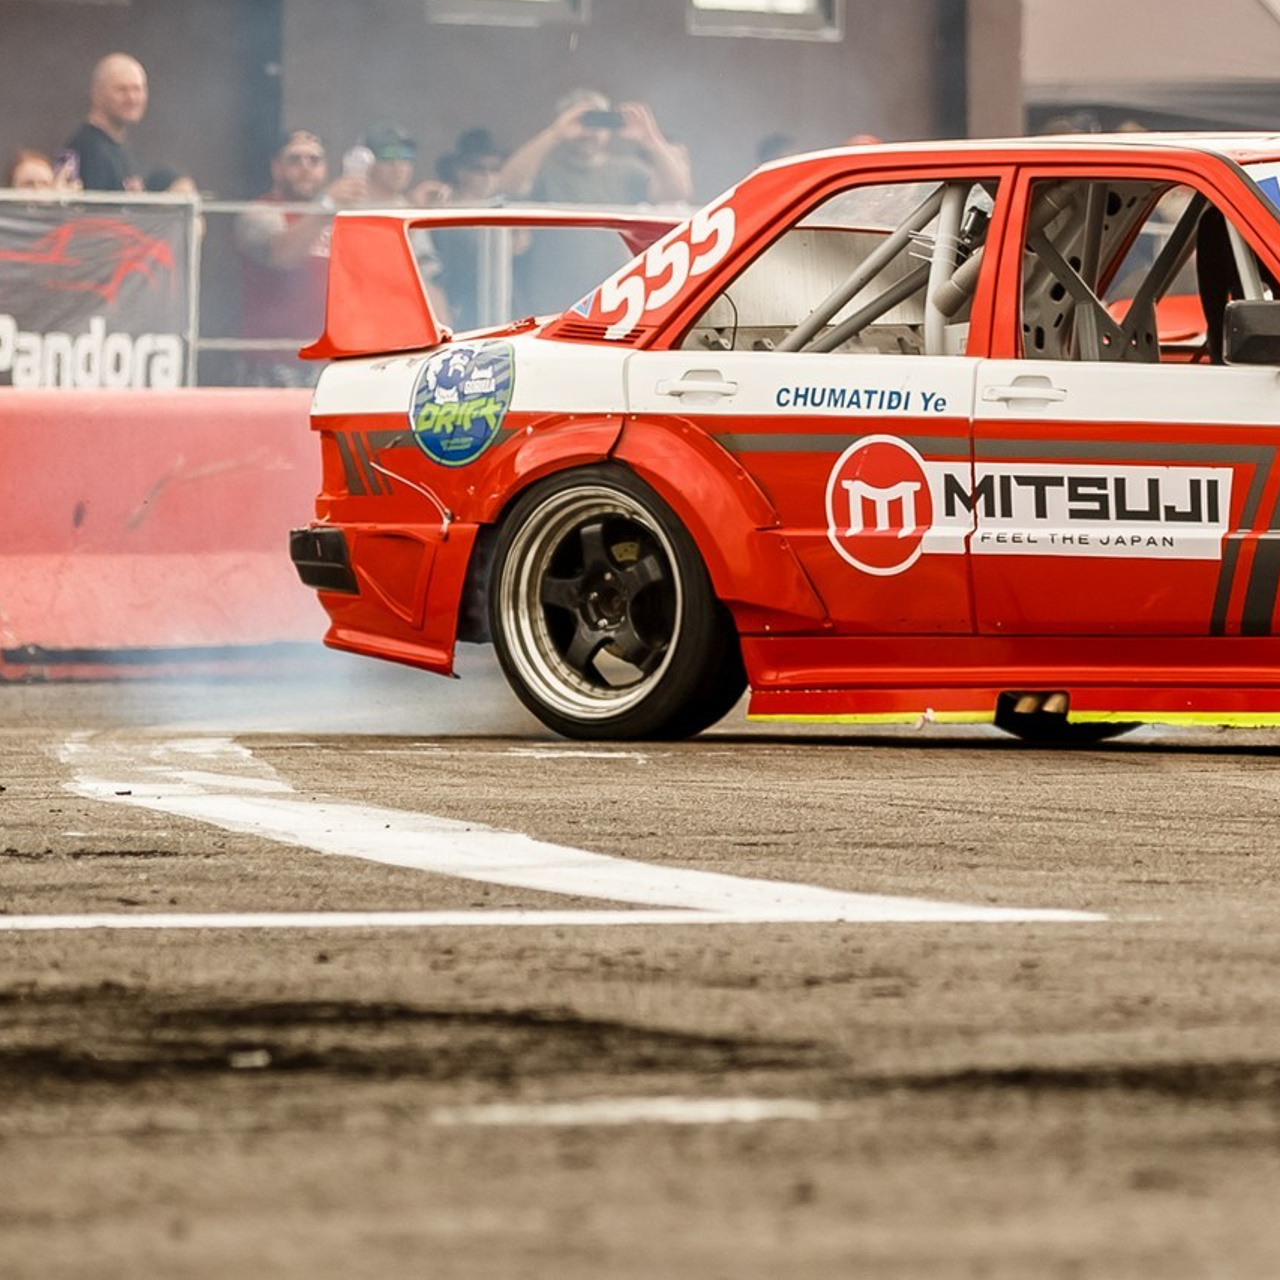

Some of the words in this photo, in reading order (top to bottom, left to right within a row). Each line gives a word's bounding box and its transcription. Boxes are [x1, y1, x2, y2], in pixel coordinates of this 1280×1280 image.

[600, 187, 737, 340] 555
[776, 387, 911, 411] CHUMATIDI
[920, 391, 947, 412] Ye
[943, 473, 1220, 523] MITSUJI
[981, 532, 1038, 545] FEEL
[1049, 533, 1090, 546] THE
[1099, 534, 1174, 548] JAPAN
